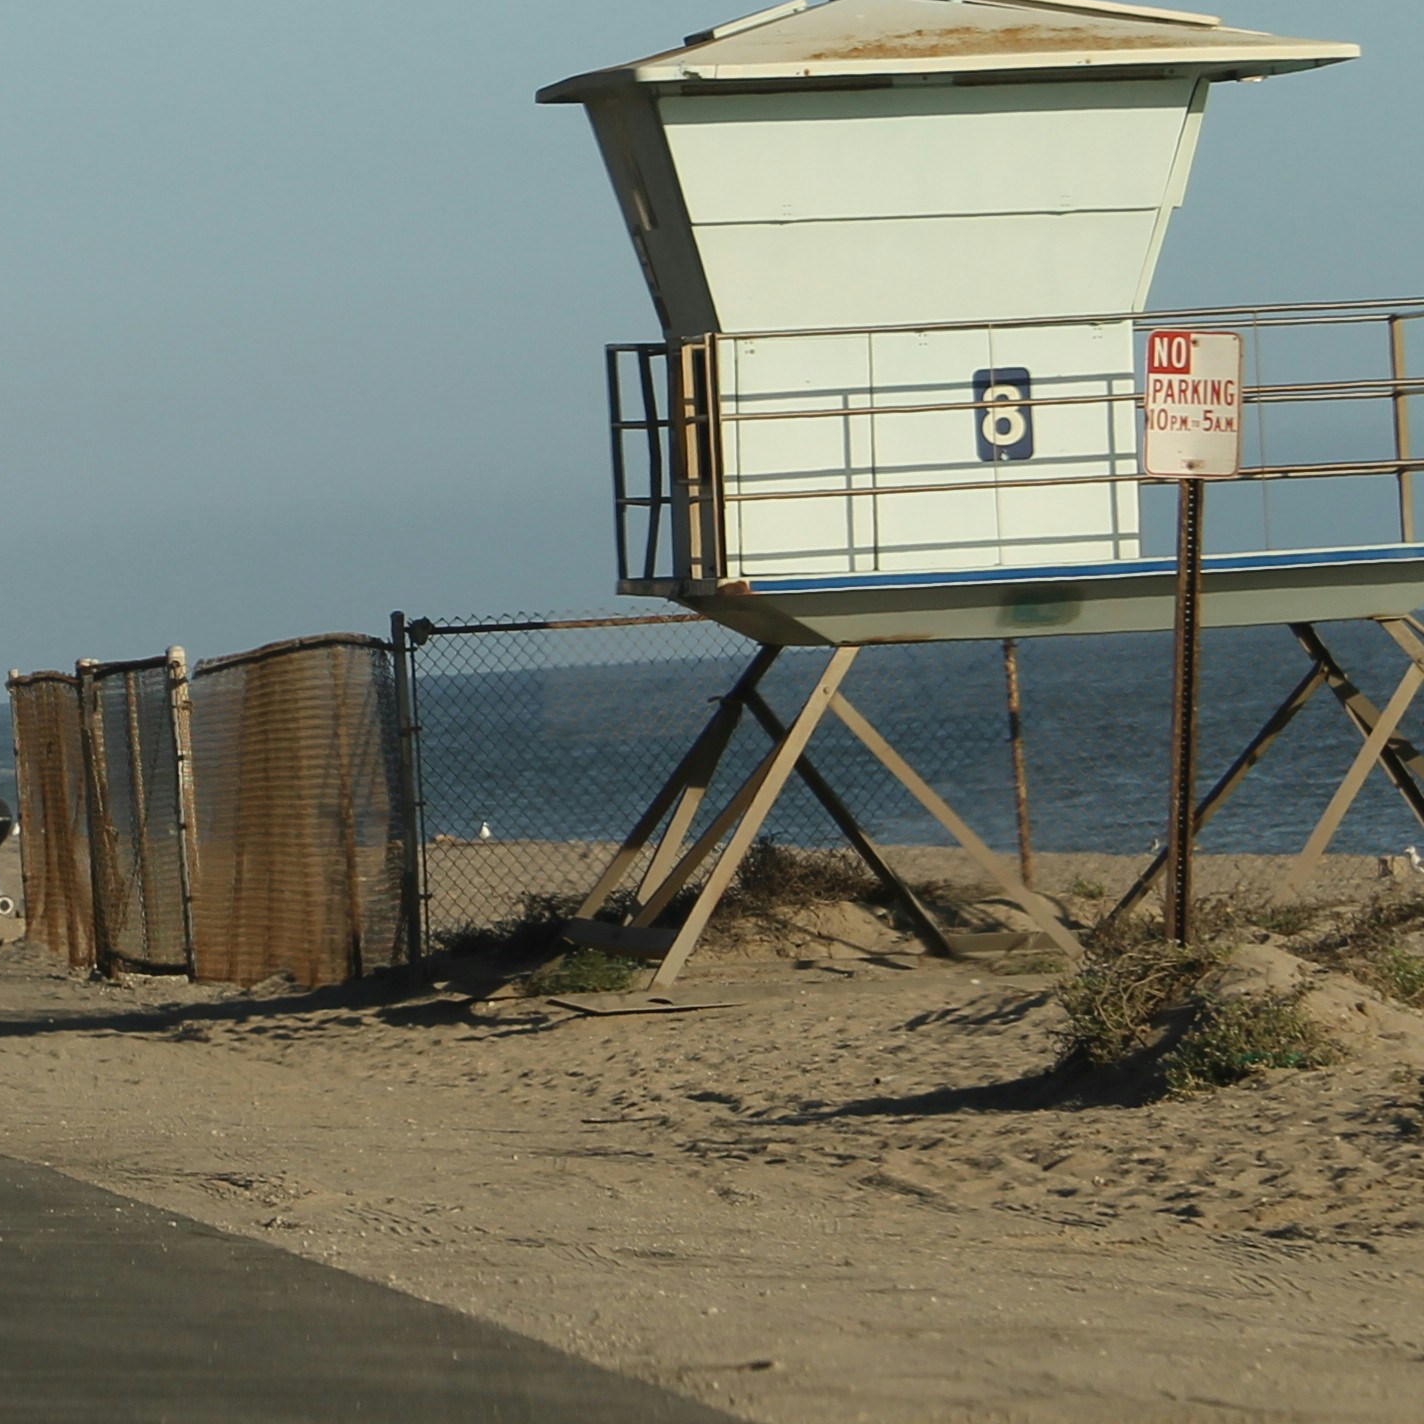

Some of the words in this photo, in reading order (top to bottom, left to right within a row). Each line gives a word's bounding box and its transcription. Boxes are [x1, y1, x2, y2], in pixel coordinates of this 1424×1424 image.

[1153, 336, 1188, 369] NO
[1152, 379, 1236, 406] PARKING
[982, 384, 1025, 446] 8
